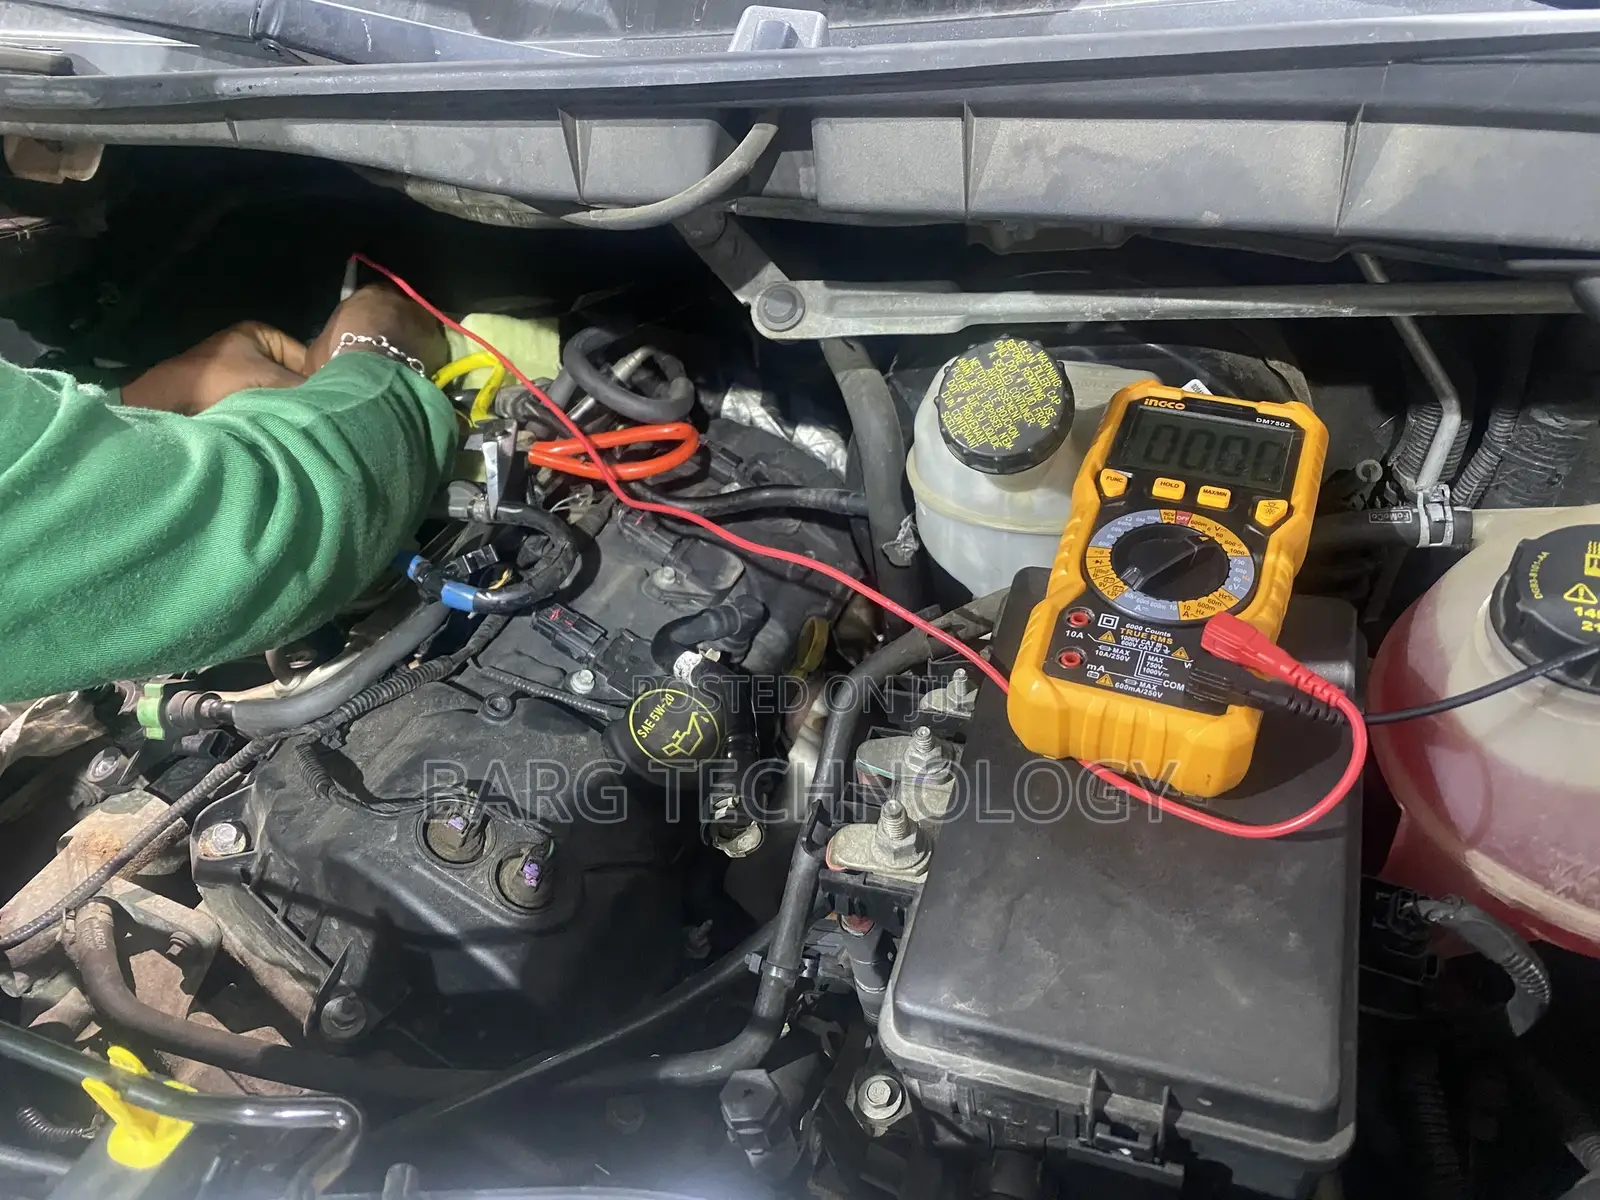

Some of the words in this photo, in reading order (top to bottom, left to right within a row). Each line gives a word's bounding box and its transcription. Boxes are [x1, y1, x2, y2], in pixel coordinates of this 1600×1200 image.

[957, 357, 974, 379] AVANT
[968, 378, 980, 389] DE
[975, 389, 986, 400] LE
[992, 358, 1013, 385] SEALED
[1005, 339, 1026, 366] BEFORE
[1043, 403, 1057, 420] USE
[1017, 341, 1037, 364] CLEAN
[1031, 364, 1051, 390] FILLER
[1047, 390, 1061, 404] CAP
[993, 340, 1010, 359] ONLY
[1005, 359, 1020, 376] DOT
[1019, 384, 1037, 406] FLUID
[1032, 406, 1050, 429] FROM
[968, 357, 994, 393] NETTOYER
[988, 392, 1001, 405] LE
[996, 405, 1020, 439] BOUCHON
[946, 379, 960, 395] DOT
[959, 403, 988, 445] PROVENANT
[950, 366, 971, 393] PLOYER
[965, 394, 980, 409] QUE
[974, 410, 987, 422] DU
[981, 422, 1003, 450] LIQUIDE
[950, 408, 980, 450] CONTENANT
[1160, 481, 1180, 489] HOLD
[1065, 630, 1084, 639] 10A
[1120, 627, 1150, 639] TRUE
[1149, 634, 1174, 645] RMS
[1125, 623, 1143, 631] 6000
[1144, 627, 1172, 637] Counts
[1120, 635, 1140, 643] 1000V
[1141, 639, 1156, 647] CAT
[1138, 644, 1153, 652] CAT
[1095, 650, 1131, 662] 10A/250V
[1112, 647, 1131, 656] MAX
[1147, 655, 1165, 664] MAX
[1086, 663, 1105, 673] mA
[1114, 682, 1164, 698] 600mA/250V
[1139, 682, 1158, 691] MAX
[1163, 680, 1186, 692] COM
[637, 718, 656, 739] SAE
[650, 693, 675, 722] 5W-20
